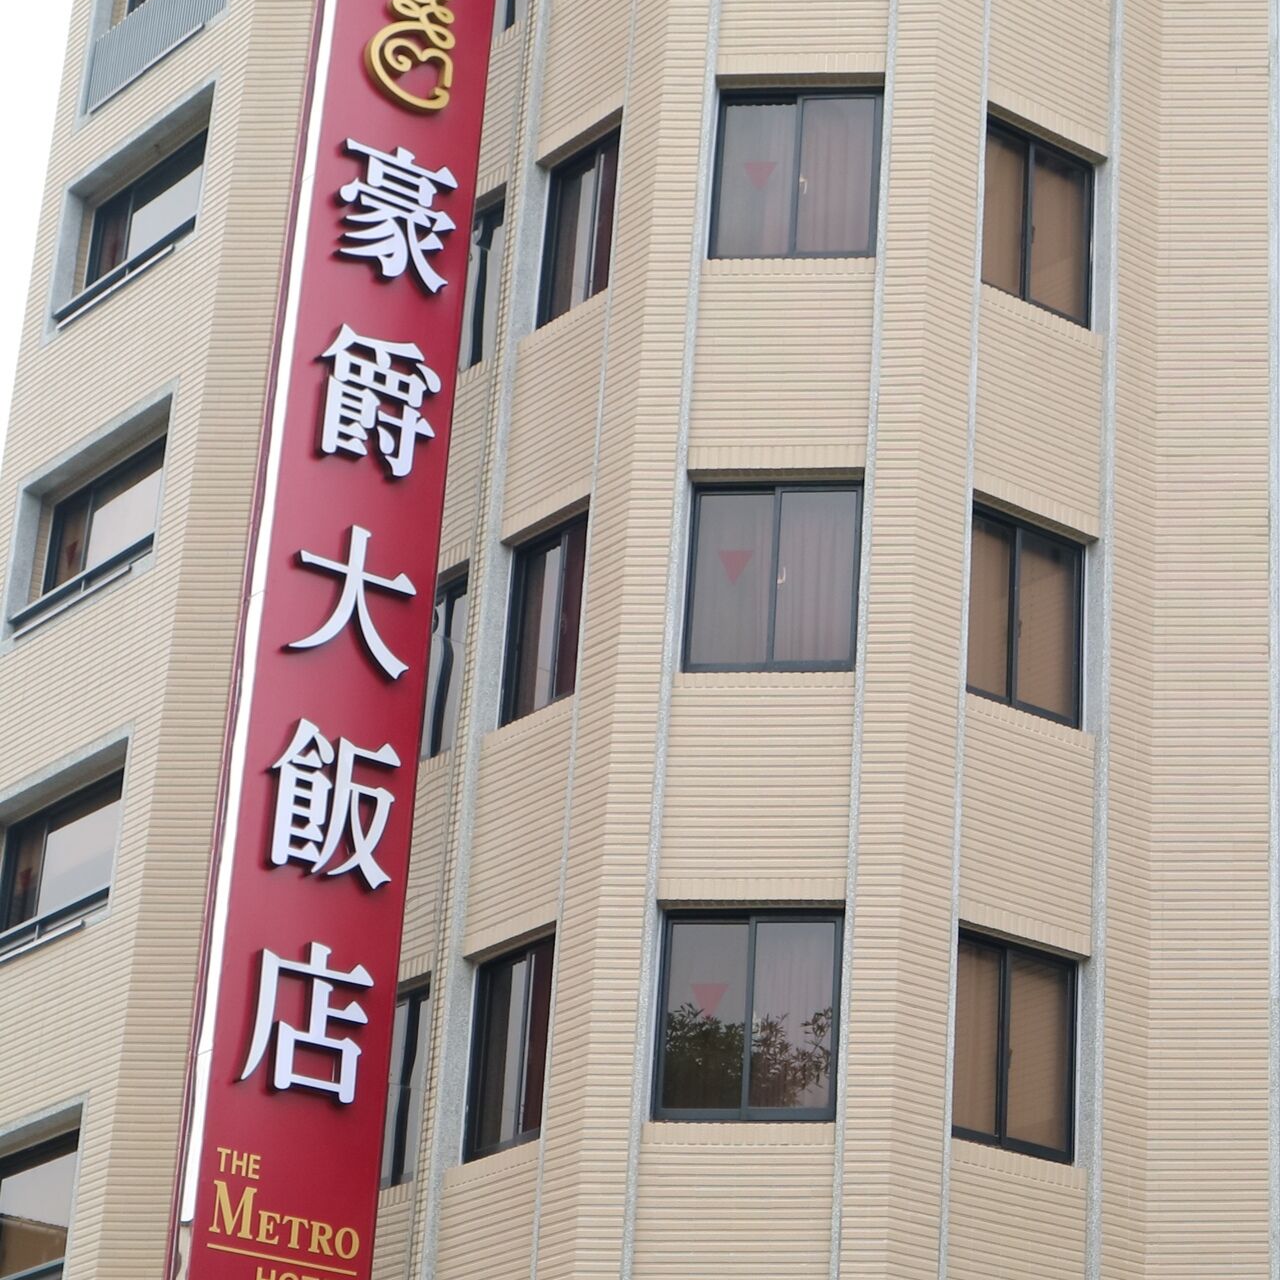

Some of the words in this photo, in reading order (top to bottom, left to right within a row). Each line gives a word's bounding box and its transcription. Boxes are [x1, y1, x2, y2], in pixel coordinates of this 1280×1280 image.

[240, 137, 459, 1106] 豪爵大飯店
[217, 1147, 261, 1180] THE
